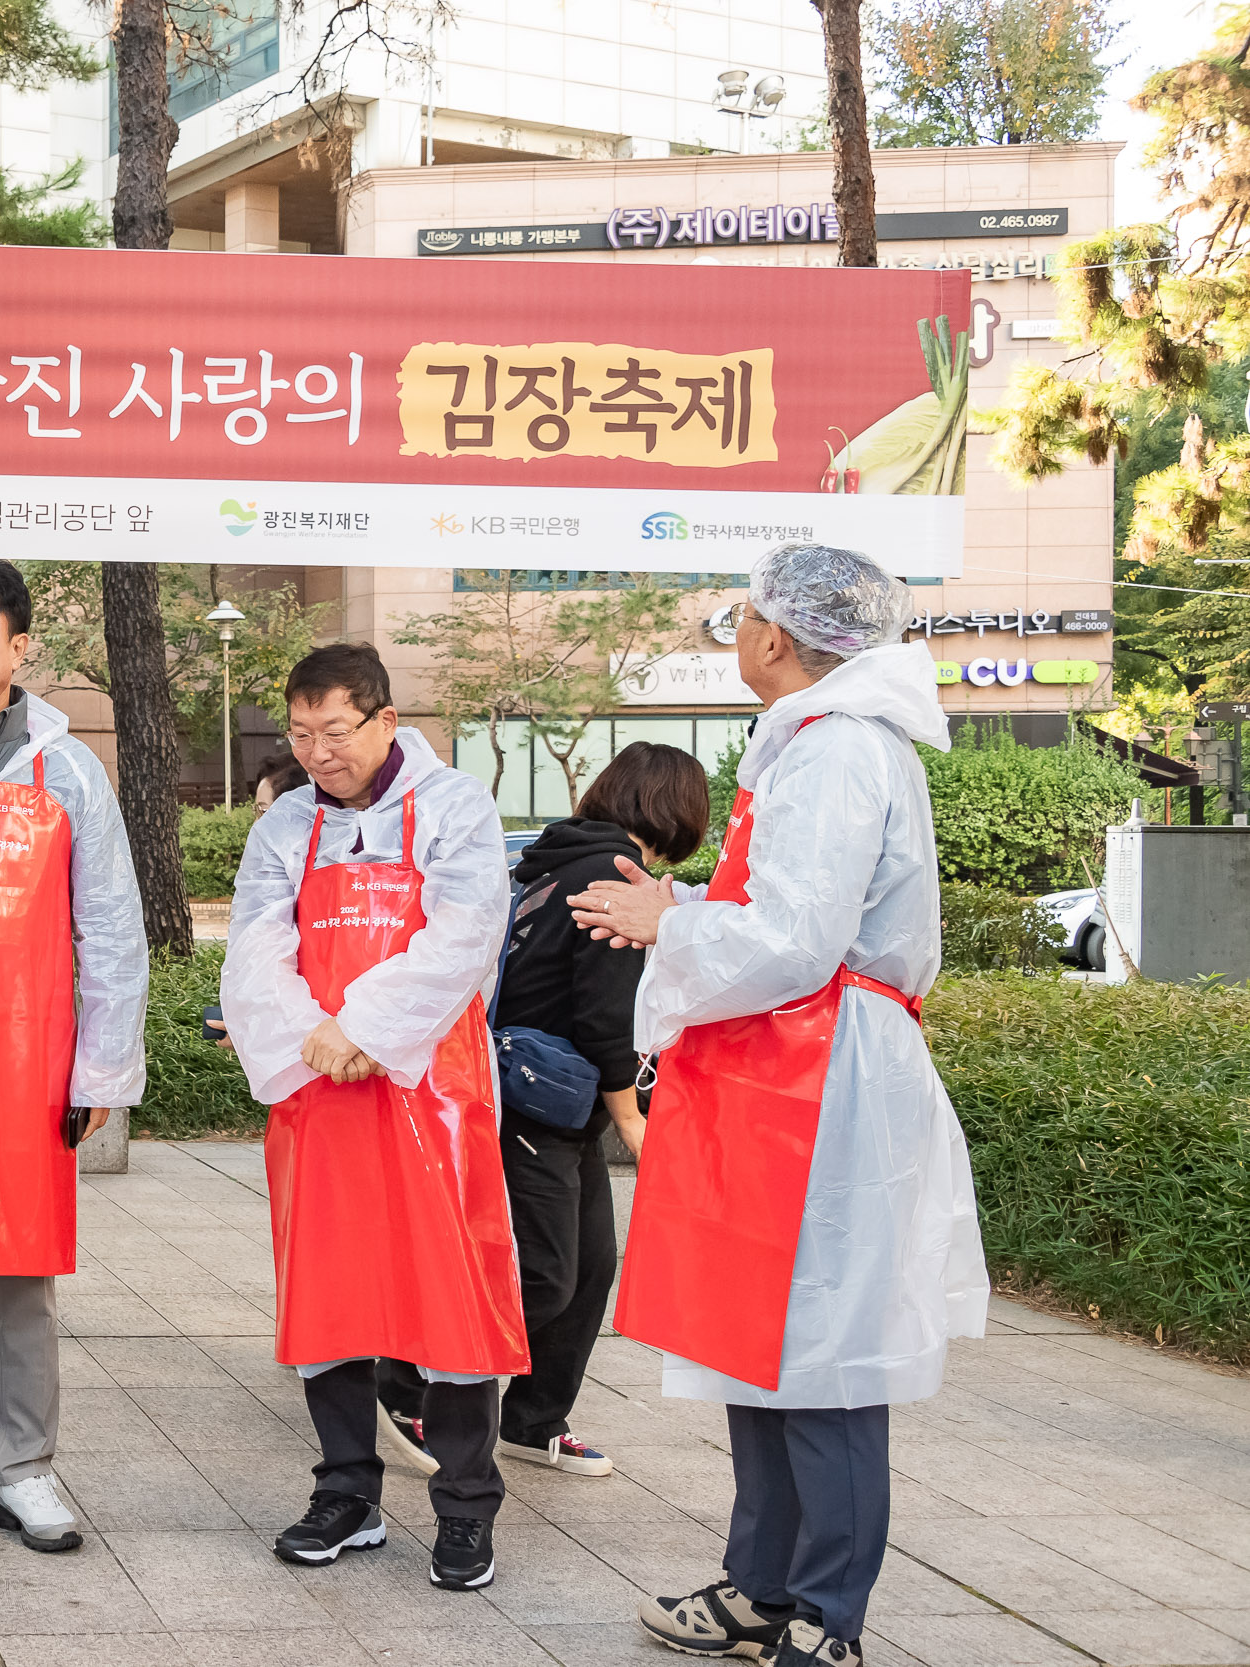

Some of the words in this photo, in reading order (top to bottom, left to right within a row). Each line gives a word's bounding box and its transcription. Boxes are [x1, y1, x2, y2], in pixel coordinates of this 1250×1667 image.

[980, 214, 1060, 229] 02.465.0987
[528, 229, 581, 245] 가맹본부
[109, 346, 364, 446] 사랑의
[426, 354, 753, 454] 김장축제
[127, 504, 154, 533] 앞
[263, 511, 370, 531] 광진복지재단
[692, 524, 813, 542] 한국사회보장정보원
[940, 666, 953, 677] to
[967, 657, 1027, 687] CU
